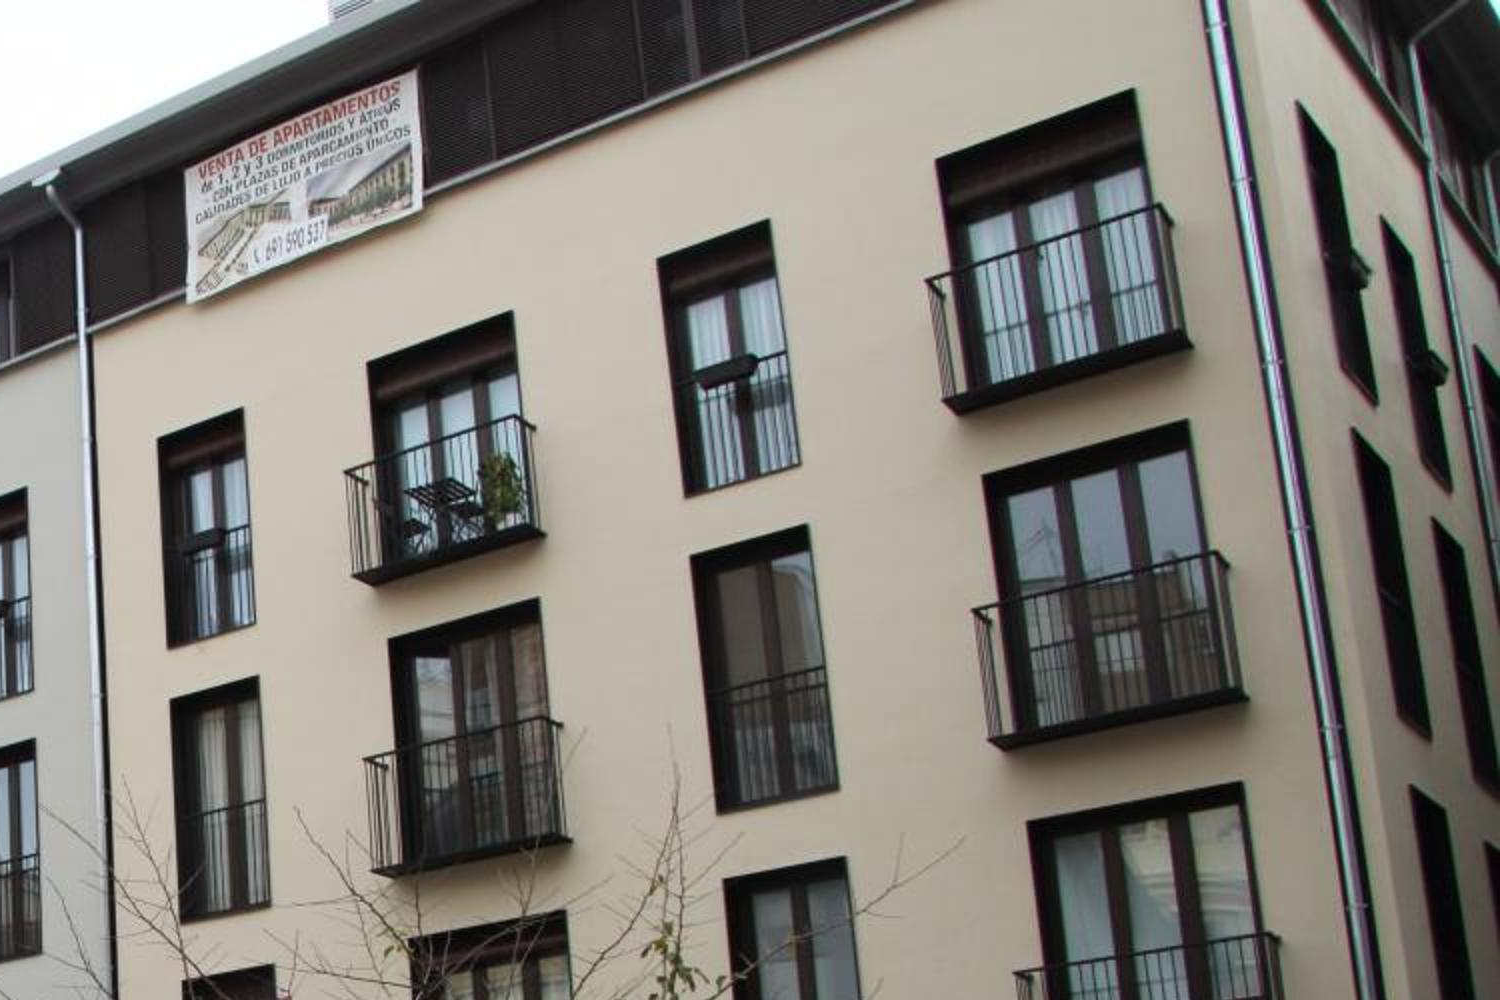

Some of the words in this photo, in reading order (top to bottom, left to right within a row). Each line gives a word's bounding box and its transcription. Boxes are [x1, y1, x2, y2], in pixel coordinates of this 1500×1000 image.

[198, 145, 245, 180] VENTA
[250, 136, 269, 158] DE
[273, 80, 401, 147] APARTAMENTOS
[212, 180, 234, 203] CON
[236, 163, 279, 193] PLAZAS
[282, 156, 296, 173] DE
[299, 118, 389, 168] APARCAMIENTO
[232, 164, 241, 180] 2
[254, 154, 264, 170] 3
[267, 123, 346, 166] DORMITORIOS
[347, 115, 356, 132] Y
[195, 192, 251, 225] CALIDADES
[255, 182, 270, 199] DE
[273, 169, 301, 191] LUJO
[303, 164, 313, 179] A
[315, 145, 364, 173] PRECIOS
